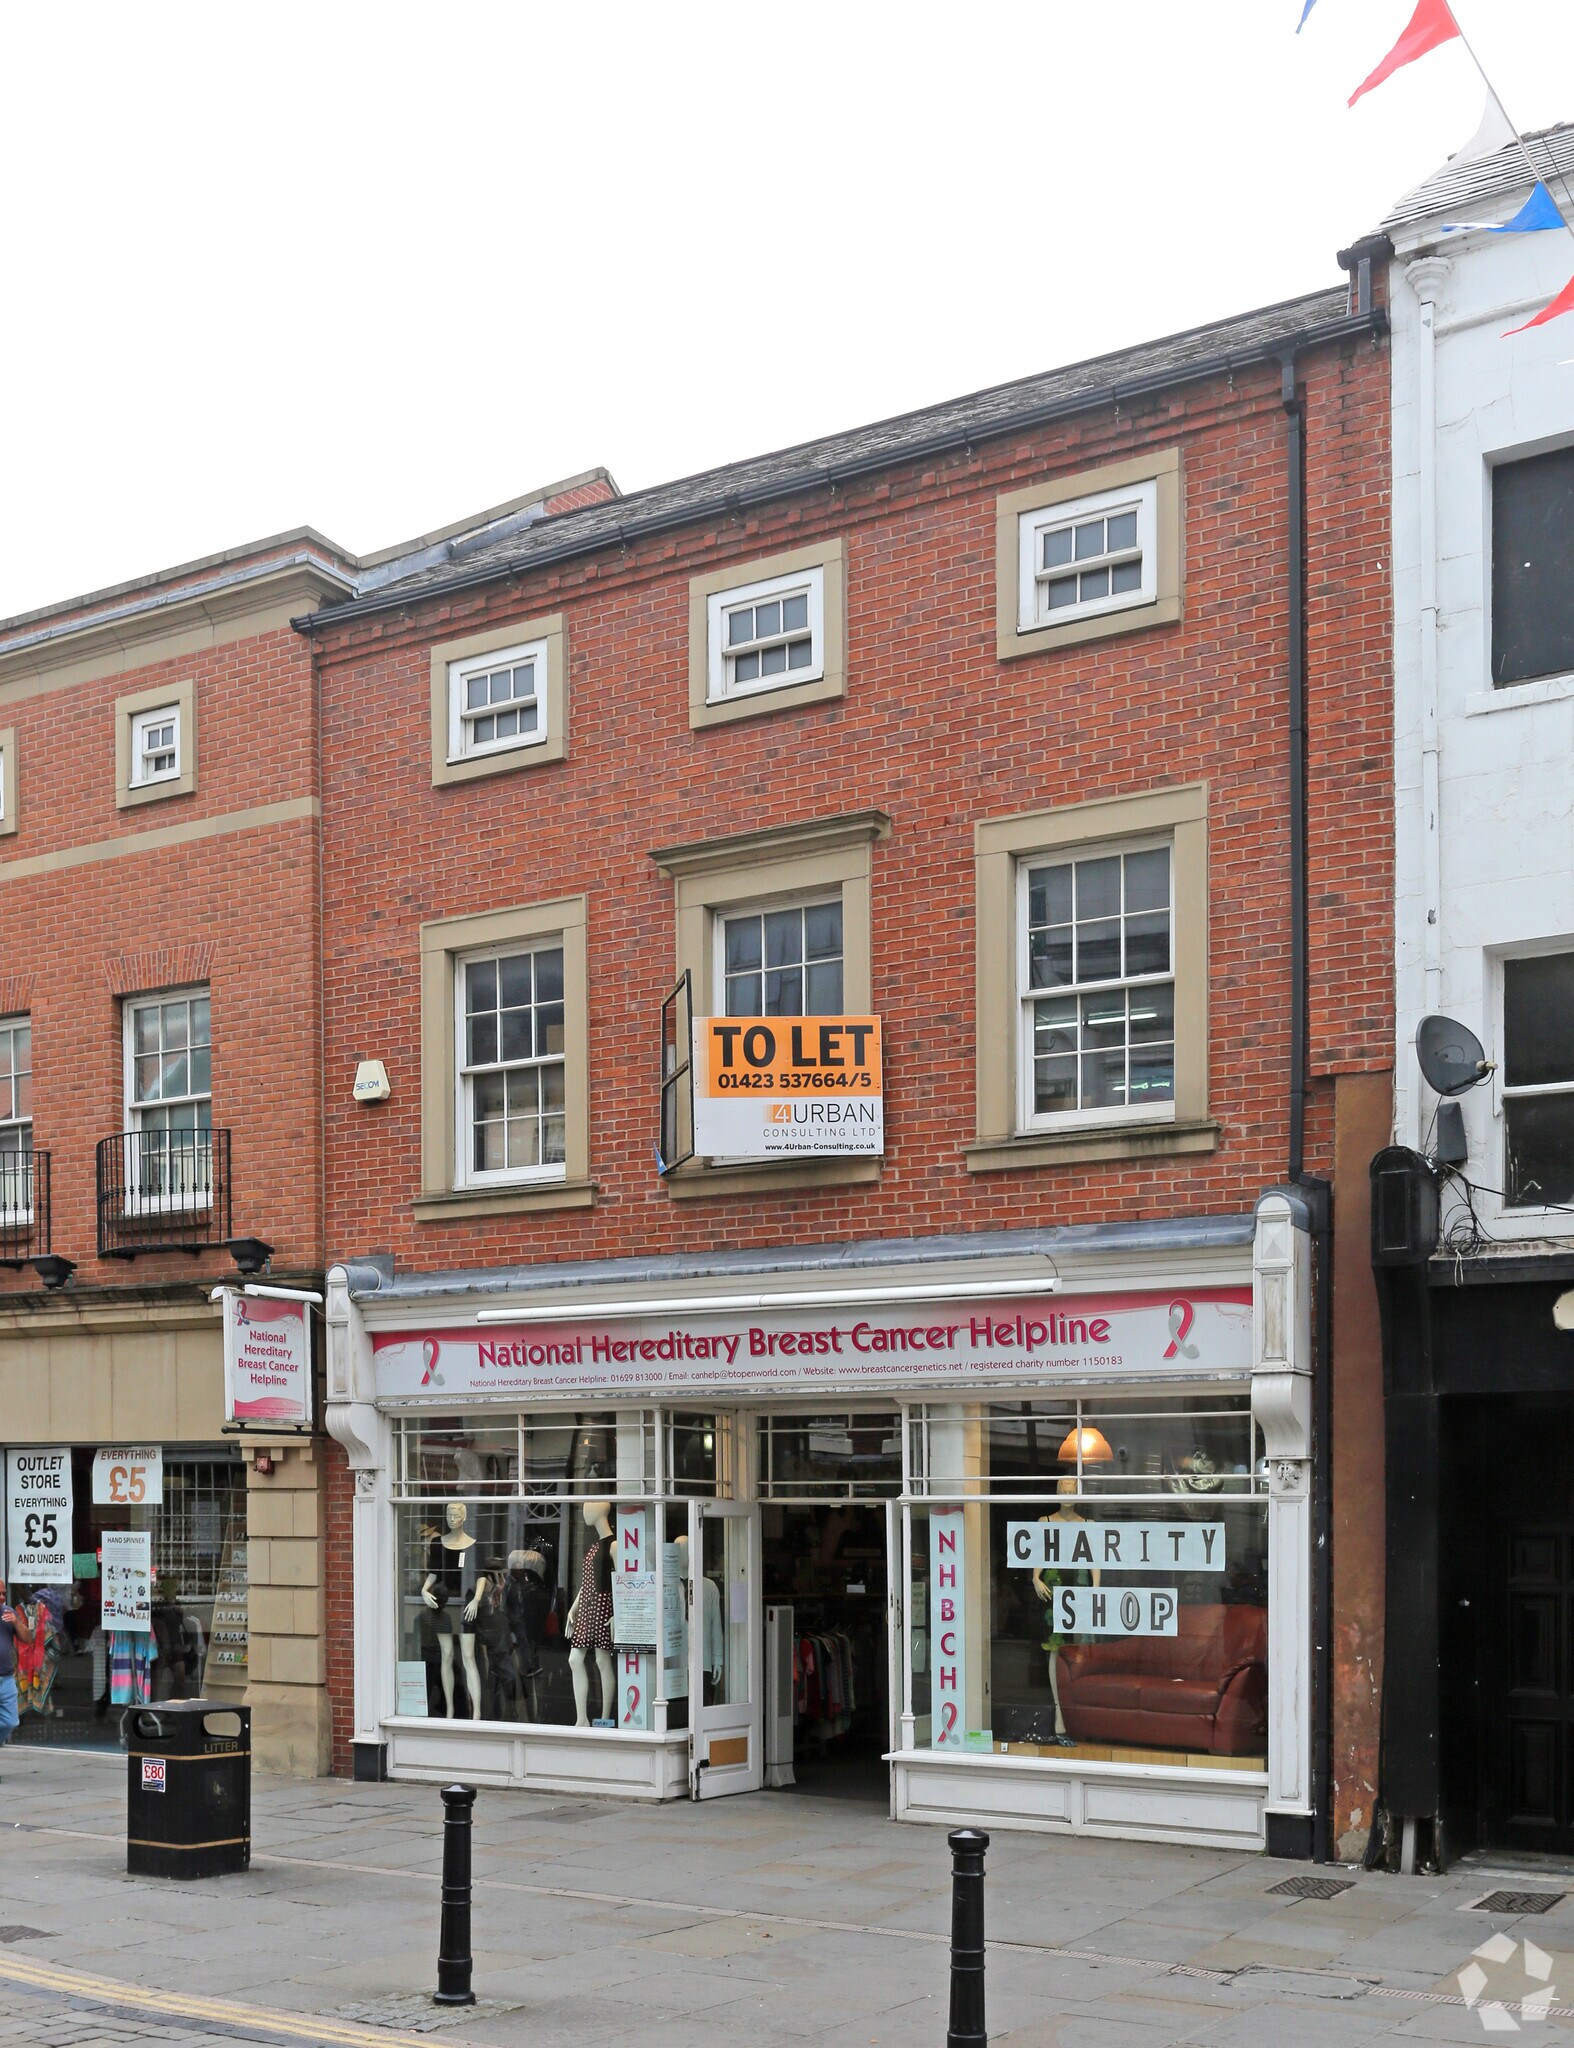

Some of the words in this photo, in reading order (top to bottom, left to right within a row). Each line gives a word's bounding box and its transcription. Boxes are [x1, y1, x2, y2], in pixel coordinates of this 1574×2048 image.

[713, 1025, 776, 1068] TO
[791, 1025, 873, 1067] LET
[356, 1080, 380, 1091] SECOM
[718, 1073, 774, 1089] 01423
[779, 1072, 872, 1088] 537664/5
[763, 1128, 846, 1138] CONSULTING
[852, 1127, 876, 1137] LTD
[764, 1142, 876, 1151] www.4Urban-Consulting.co.uk
[249, 1330, 287, 1343] National
[478, 1336, 582, 1368] National
[591, 1330, 741, 1364] Hereditary
[749, 1326, 842, 1357] Breast
[851, 1322, 959, 1353] Cancer
[970, 1311, 1111, 1353] Helpline
[244, 1344, 292, 1359] Hereditary
[238, 1358, 267, 1371] Breast
[268, 1360, 299, 1373] Cancer
[470, 1378, 496, 1387] National
[497, 1377, 532, 1386] Hereditary
[533, 1376, 553, 1385] Breast
[554, 1375, 578, 1384] Cancer
[579, 1374, 609, 1384] Helpline:
[610, 1373, 634, 1382] 01629
[803, 1366, 836, 1376] Website:
[838, 1361, 963, 1374] www.breastcancergenetics.net
[970, 1360, 1013, 1371] registered
[1015, 1358, 1044, 1369] charity
[1046, 1358, 1080, 1367] number
[1083, 1356, 1123, 1366] 1150183
[250, 1374, 287, 1386] Helpline
[100, 1449, 156, 1461] EVERYTHING
[17, 1456, 64, 1472] OUTLET
[20, 1474, 61, 1490] STORE
[109, 1466, 146, 1503] £5
[14, 1497, 67, 1508] EVERYTHING
[24, 1513, 58, 1549] £5
[107, 1536, 123, 1544] HAND
[123, 1536, 146, 1544] SPINNER
[1013, 1528, 1217, 1565] CHARITY
[17, 1554, 35, 1564] AND
[37, 1554, 66, 1564] UNDER
[1061, 1589, 1174, 1632] SHOP
[204, 1741, 238, 1753] LITTER
[144, 1765, 164, 1779] £80
